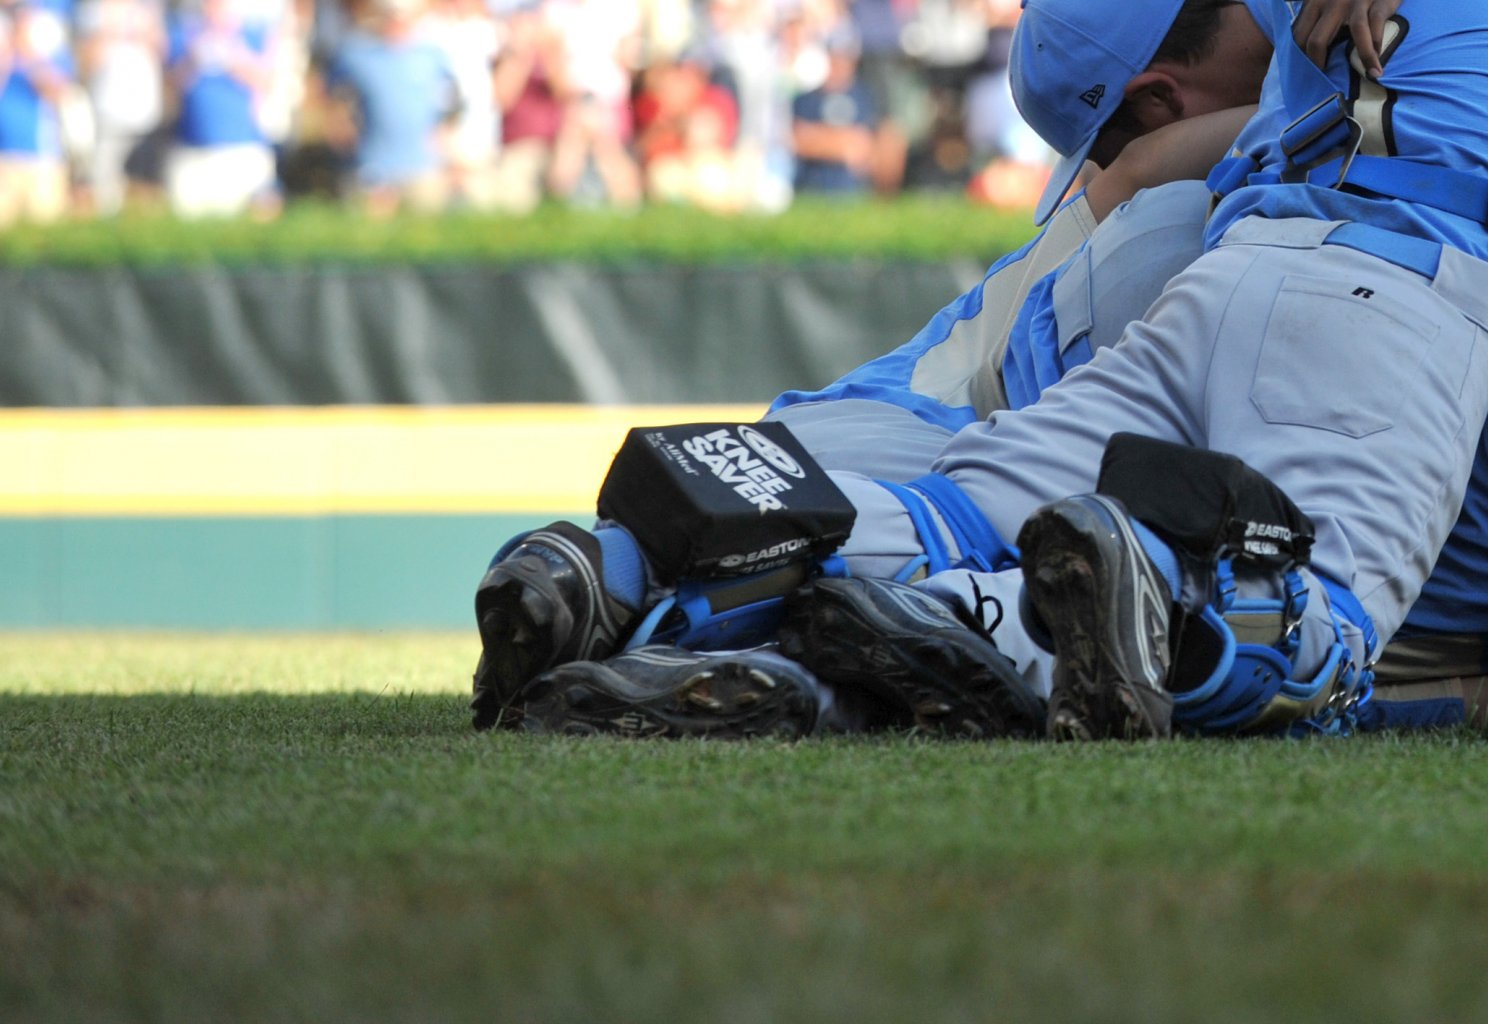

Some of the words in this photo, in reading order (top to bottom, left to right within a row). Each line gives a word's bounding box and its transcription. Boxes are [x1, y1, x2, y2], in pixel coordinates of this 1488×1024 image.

[682, 436, 782, 516] SAVER
[704, 428, 793, 495] KNEE
[745, 537, 809, 563] EASTON
[1257, 523, 1293, 542] EASTO
